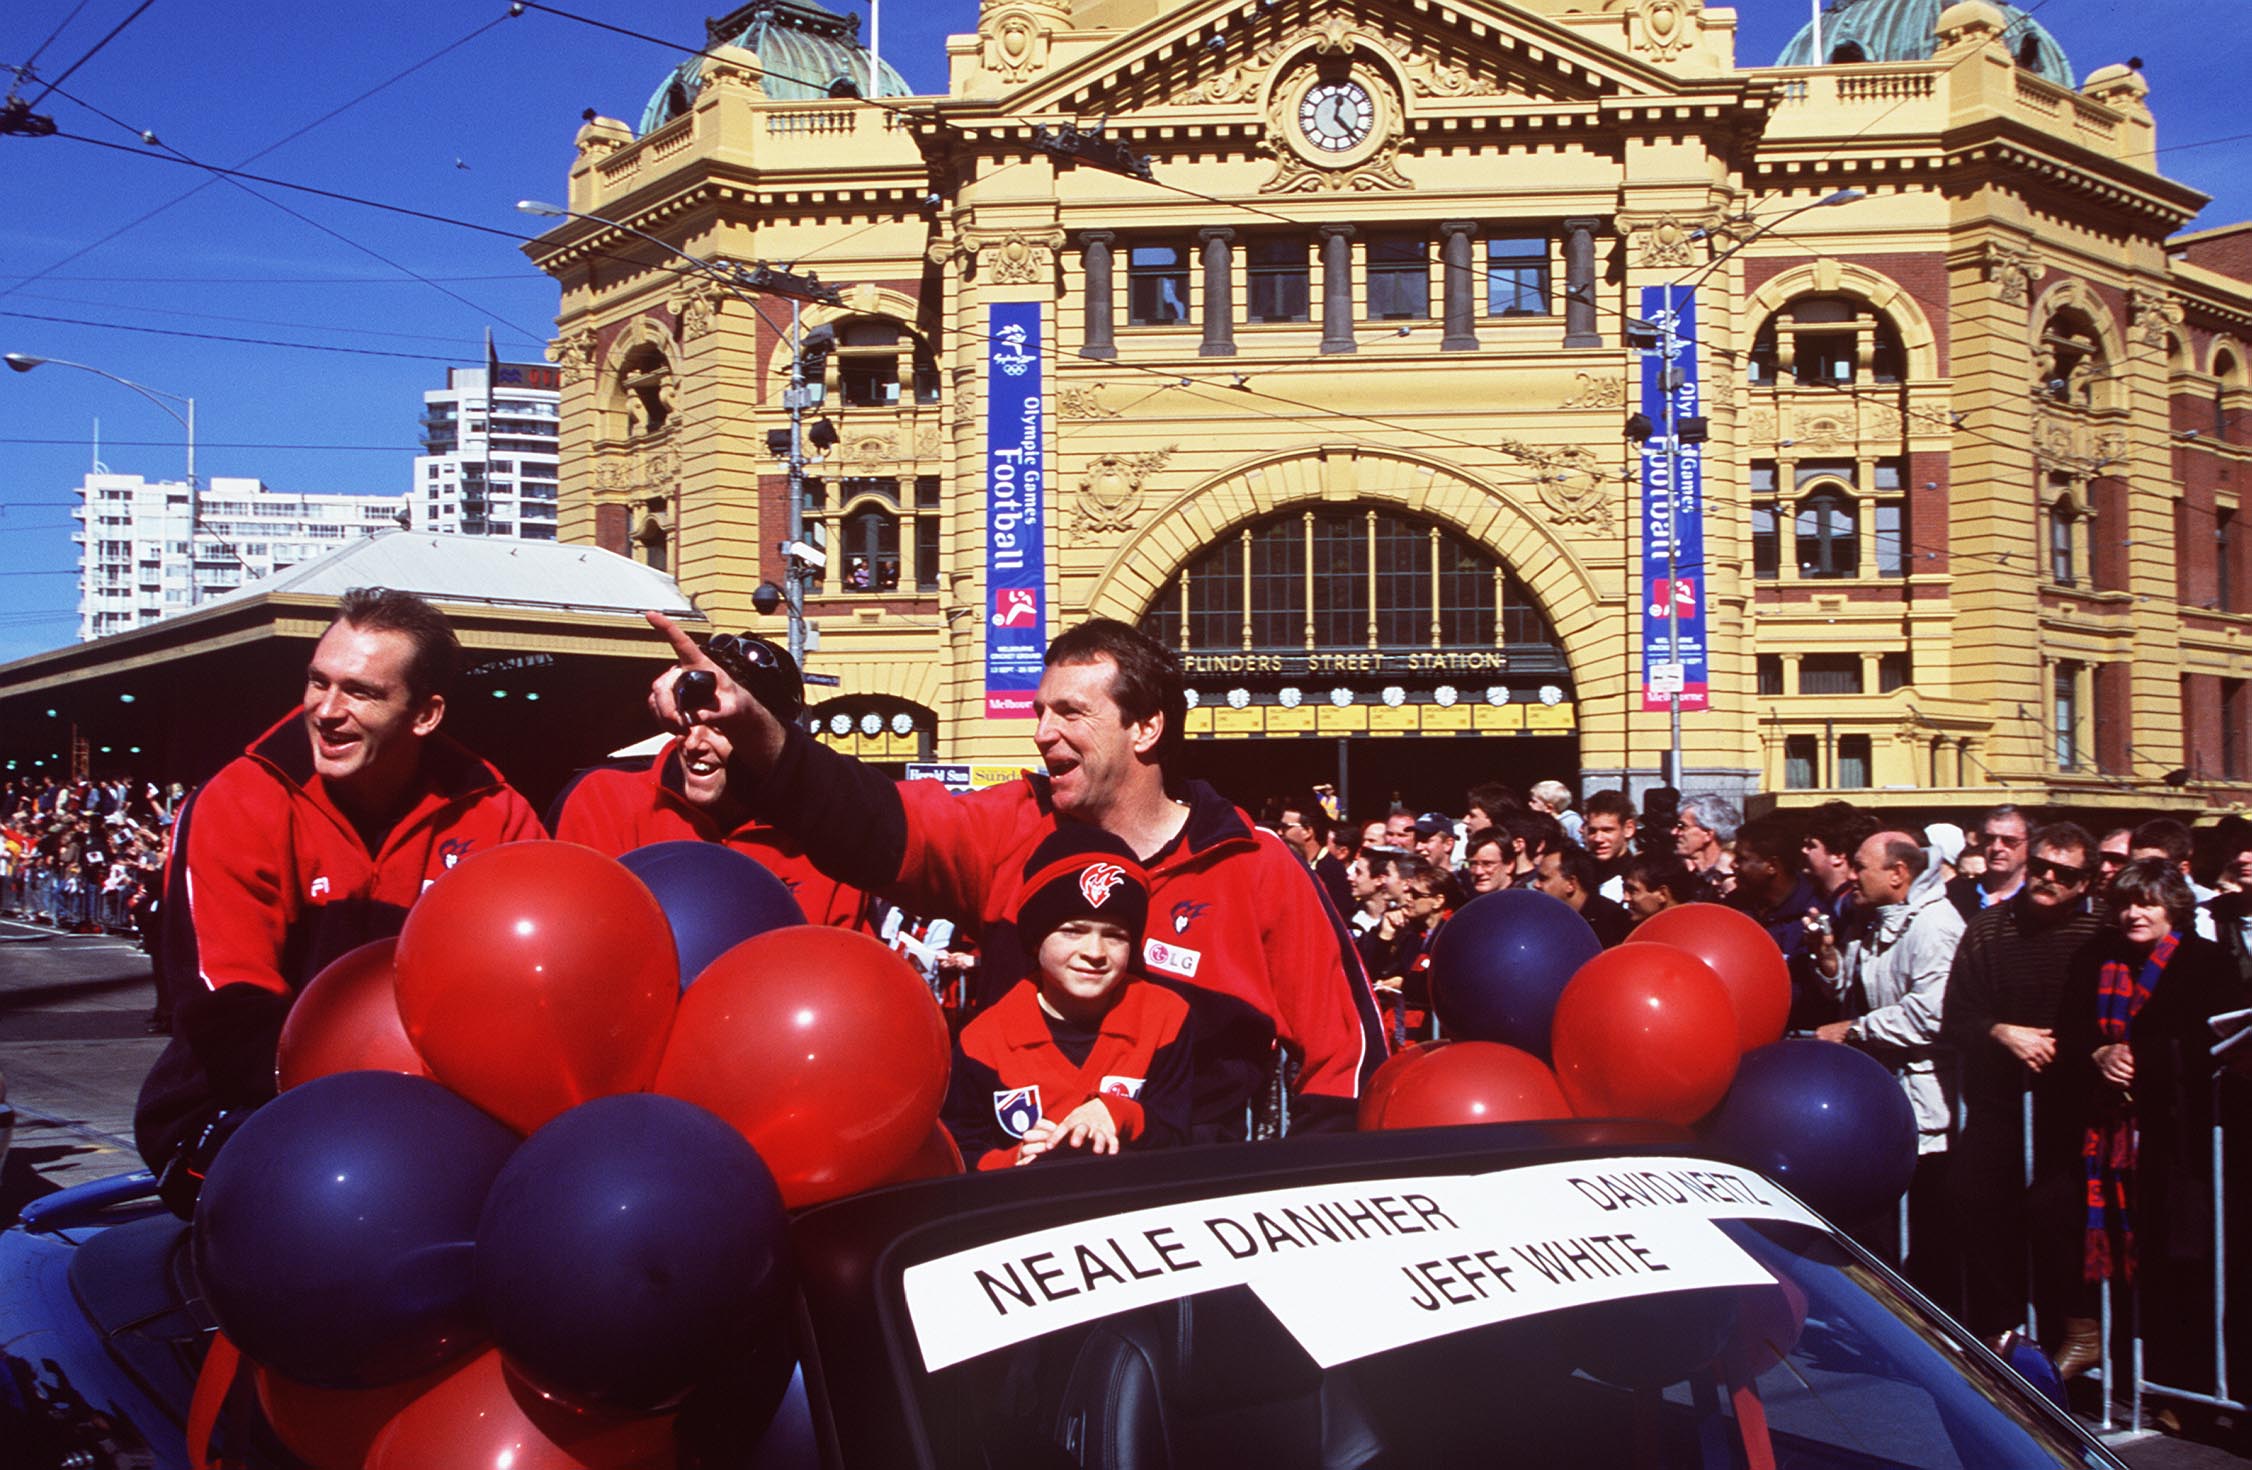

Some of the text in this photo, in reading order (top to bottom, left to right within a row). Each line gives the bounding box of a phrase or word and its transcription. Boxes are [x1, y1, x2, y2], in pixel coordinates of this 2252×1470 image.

[1021, 397, 1041, 526] Olympic Games
[1681, 458, 1698, 513] Games
[993, 447, 1024, 570] Football
[1183, 652, 1502, 672] FLINDERS STREET STATION
[1169, 952, 1194, 970] LG
[1566, 1170, 1773, 1212] DAVID NEITZ
[973, 1193, 1461, 1316] NEALE DANIHER
[1400, 1233, 1671, 1312] JEFF WHITE
